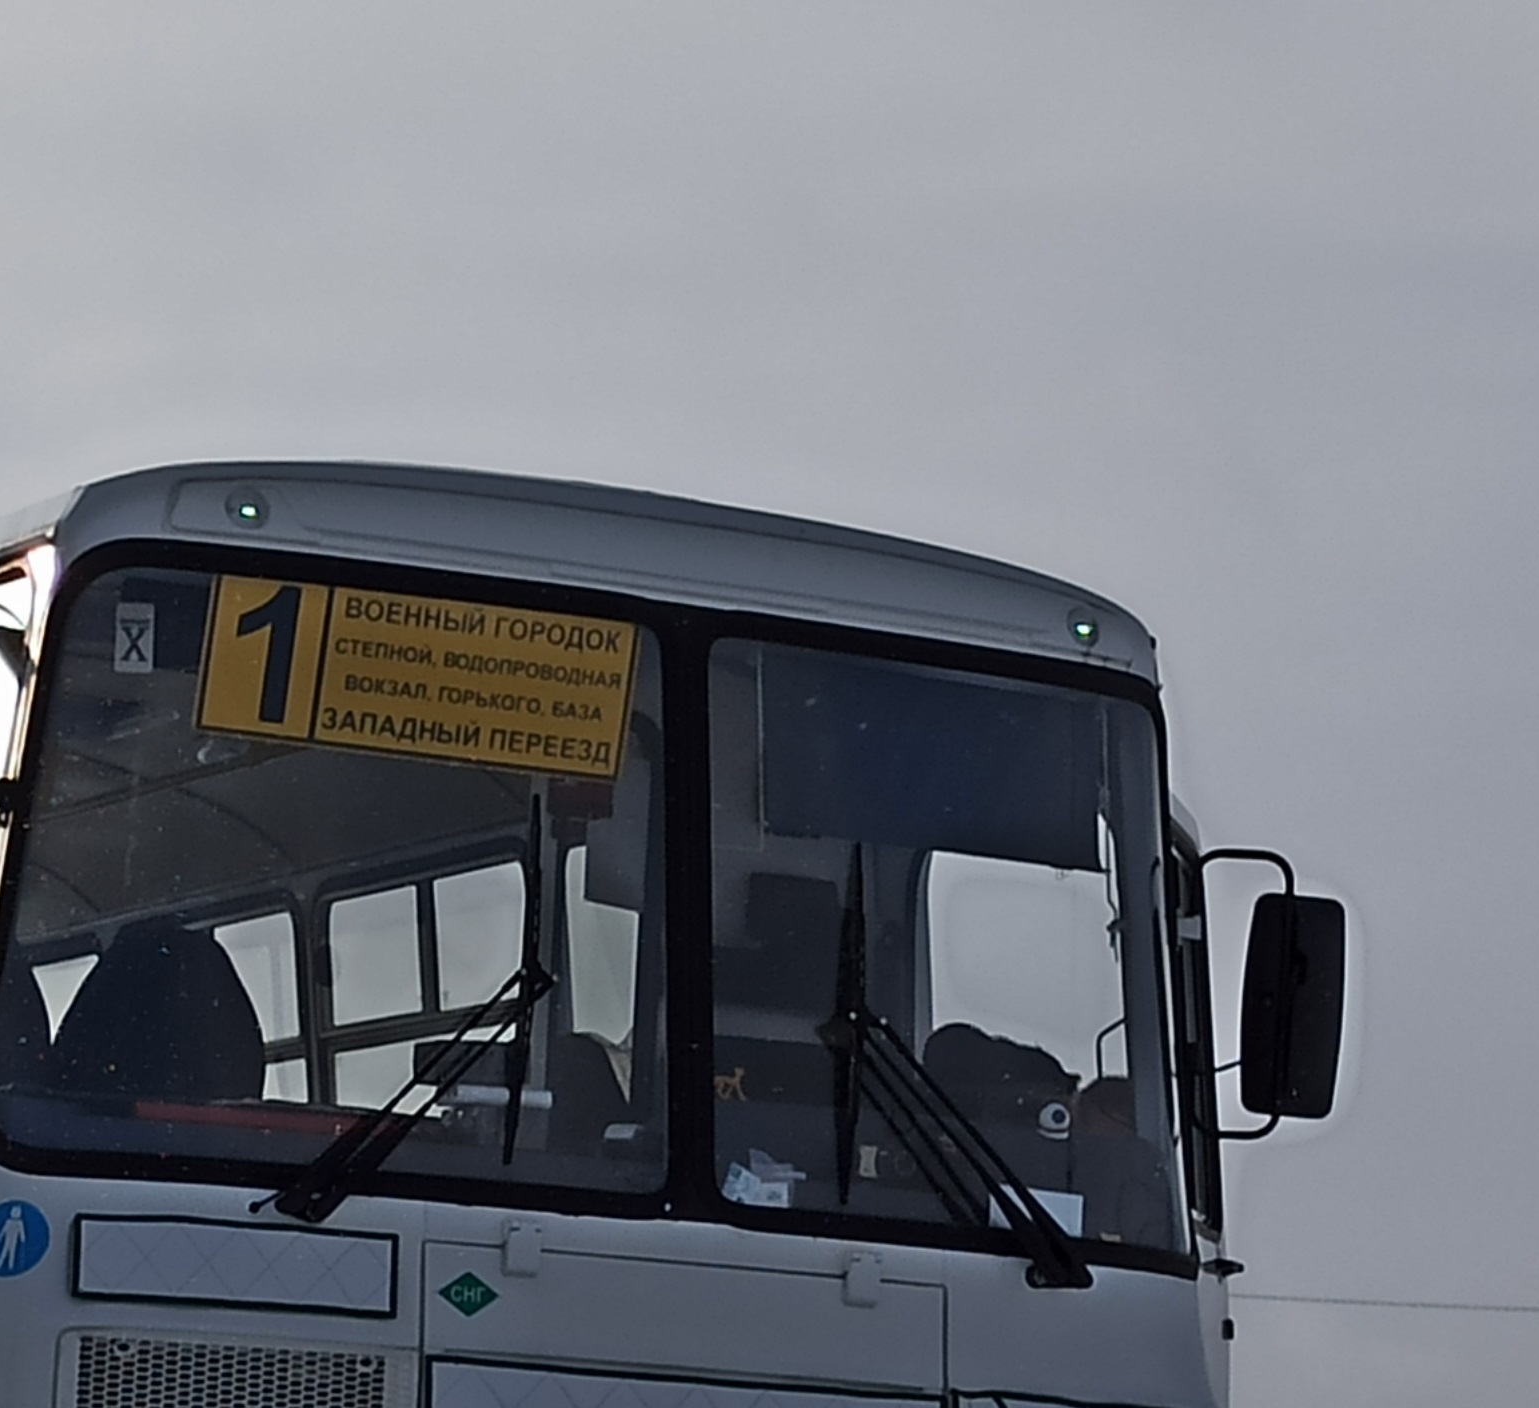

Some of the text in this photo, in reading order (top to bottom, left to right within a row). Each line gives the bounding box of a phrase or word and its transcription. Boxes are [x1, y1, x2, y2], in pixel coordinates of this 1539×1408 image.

[344, 596, 623, 654] ВОЕННЫЙ ГОРОДОК
[236, 585, 303, 724] 1
[334, 637, 623, 690] СТЕПНОЙ, ВОДОПРОВОДНАЯ
[320, 707, 612, 768] ЗАПАДНЫЙ ПЕРЕЕЗД
[551, 700, 603, 722] БАЗА
[449, 1284, 487, 1305] СНГ
